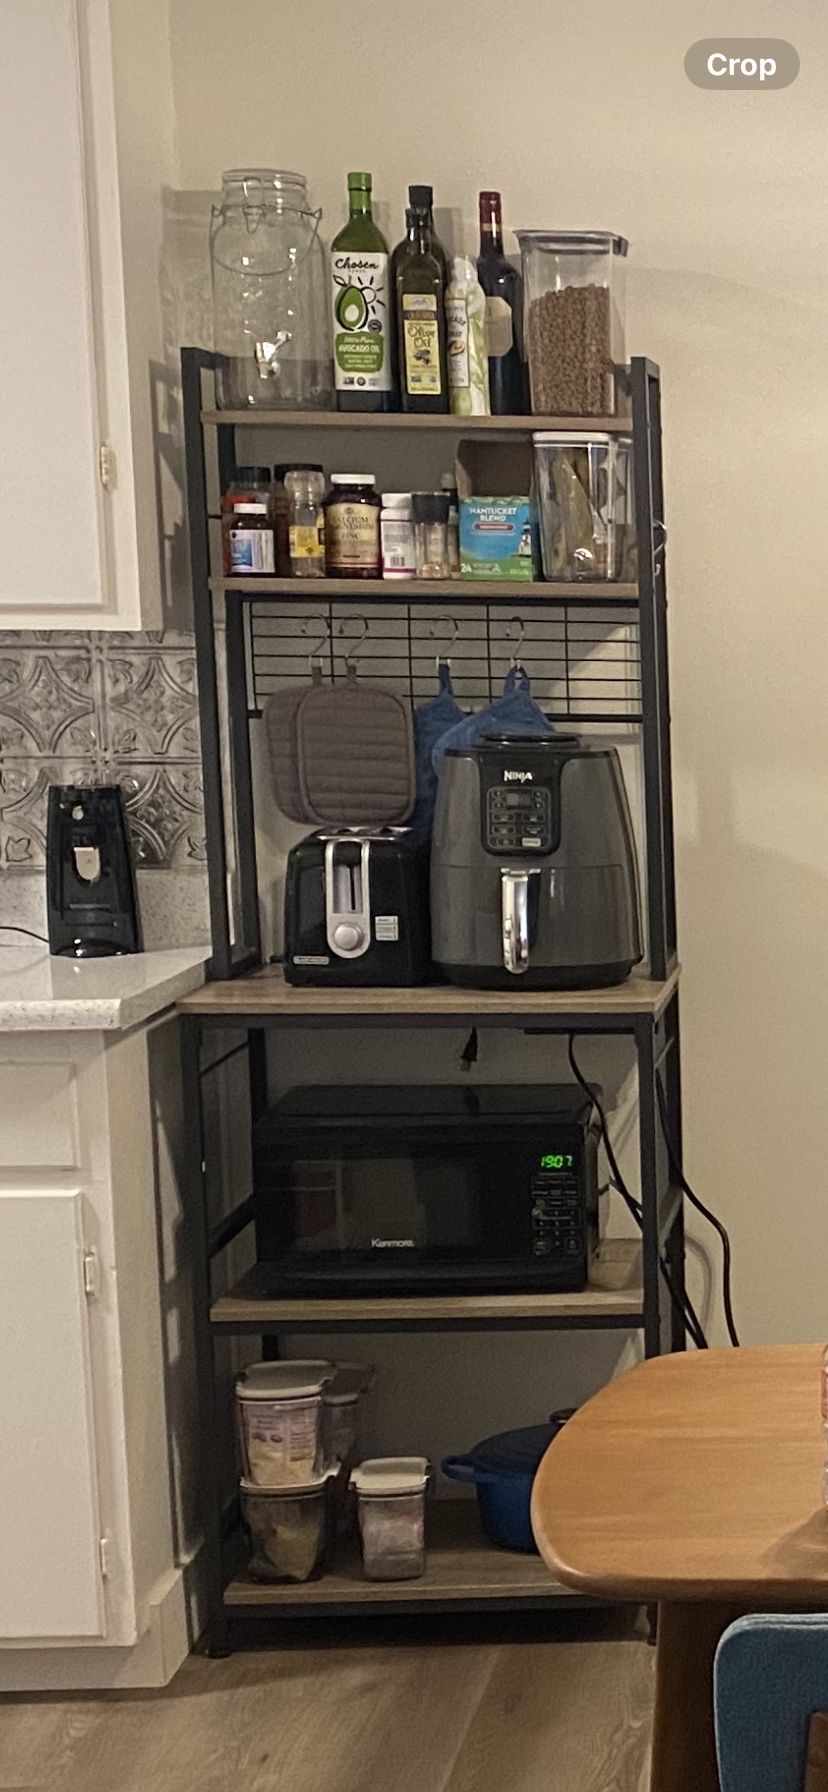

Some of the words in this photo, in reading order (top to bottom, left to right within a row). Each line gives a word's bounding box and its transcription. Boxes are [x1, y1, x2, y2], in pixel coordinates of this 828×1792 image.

[335, 257, 378, 269] Chosen
[408, 326, 435, 337] Olive
[414, 337, 431, 347] Oil
[338, 344, 369, 352] AVOCADO
[370, 345, 380, 353] OIL
[469, 507, 517, 515] NANTUCKET
[461, 563, 473, 573] 24
[503, 770, 533, 783] NINJA
[371, 1238, 415, 1248] Kenmore
